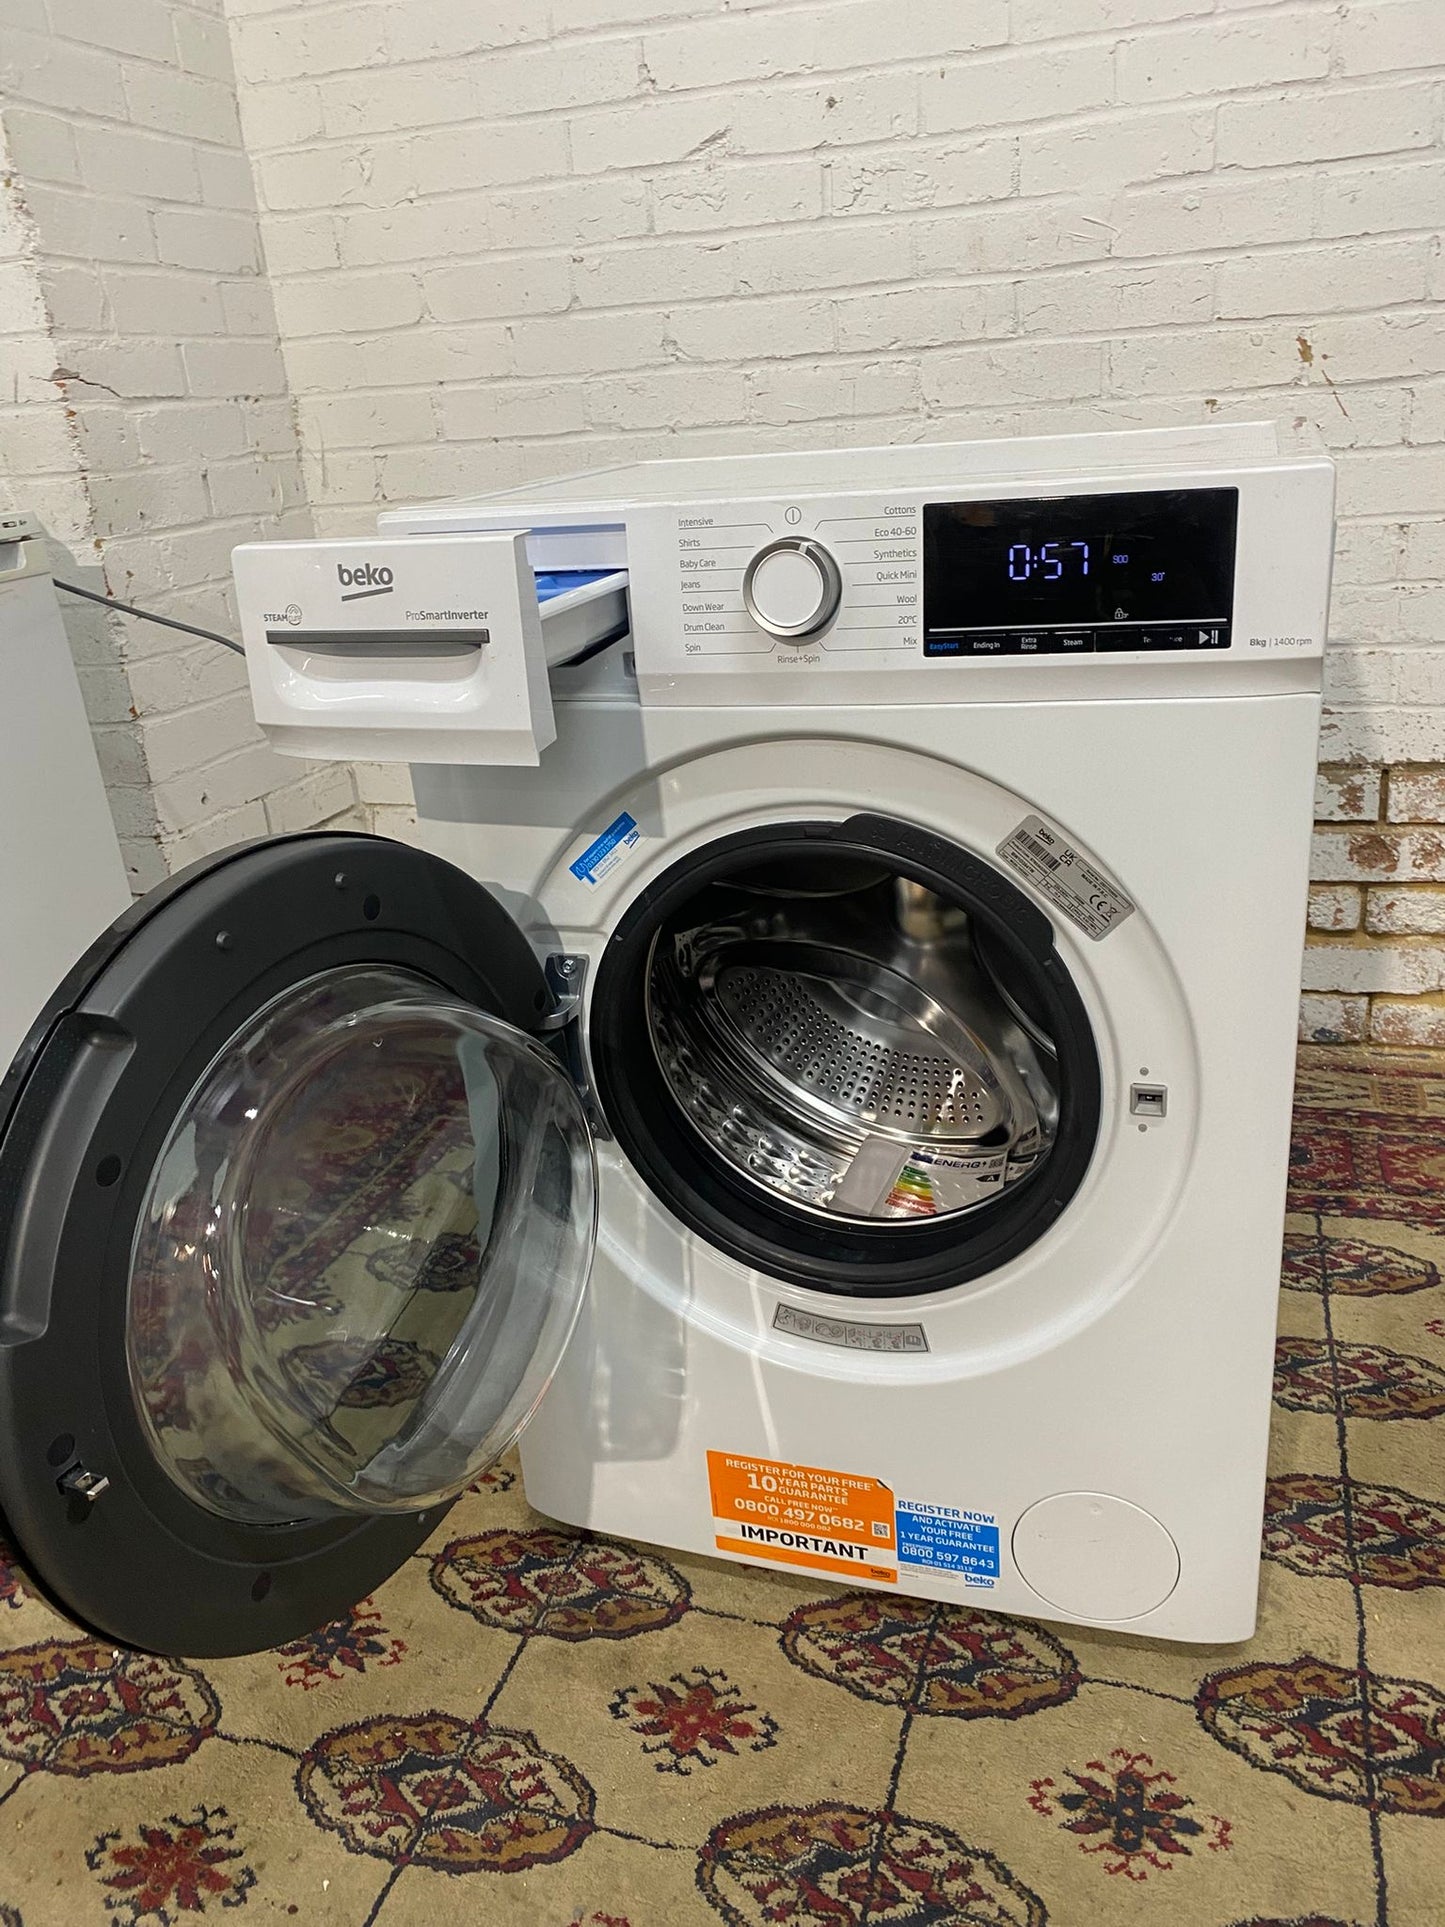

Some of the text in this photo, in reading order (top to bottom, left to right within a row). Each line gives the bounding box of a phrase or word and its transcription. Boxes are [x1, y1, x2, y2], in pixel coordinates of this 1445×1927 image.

[884, 506, 916, 515] Cottons
[678, 517, 714, 527] Intensive
[874, 527, 917, 537] Eco 40-60
[679, 539, 701, 548] Shirts
[873, 550, 917, 560] Synthetics
[1009, 541, 1090, 580] 0:57
[680, 559, 716, 569] Baby Care
[337, 563, 394, 586] beko
[876, 570, 917, 581] Quick Mini
[681, 580, 701, 590] Jeans
[896, 595, 917, 604] Wool
[682, 602, 724, 612] Down Wear
[405, 609, 489, 621] ProSmartInverter
[897, 615, 917, 624] 20°C
[683, 622, 725, 632] Drum Clean
[903, 637, 917, 646] Mix
[973, 642, 994, 650] Ending
[1063, 638, 1083, 647] Steam
[1250, 637, 1313, 647] 8kg 1400 rpm
[685, 643, 701, 652] Spin
[777, 655, 820, 665] Rinse+Spin
[623, 831, 639, 845] beko
[1038, 828, 1055, 845] beko
[1064, 849, 1078, 860] UK
[1089, 894, 1108, 911] CE
[725, 1458, 780, 1476] REGISTER
[782, 1468, 805, 1480] FOR
[807, 1472, 842, 1486] YOUR
[747, 1473, 778, 1493] 10
[777, 1476, 849, 1497] YEAR PARTS
[778, 1486, 849, 1506] GUARANTEE
[764, 1495, 787, 1505] CALL
[787, 1499, 809, 1509] FREE
[734, 1497, 865, 1532] 0800 497 0682
[898, 1500, 995, 1523] REGISTER NOW
[912, 1515, 982, 1533] AND ACTIVATE
[920, 1525, 974, 1541] YOUR FREE
[740, 1524, 869, 1560] IMPORTANT
[900, 1531, 995, 1554] 1 YEAR GUARANTEE
[902, 1546, 994, 1569] 0800 597 8643
[870, 1568, 891, 1578] beko
[965, 1574, 995, 1586] beko
